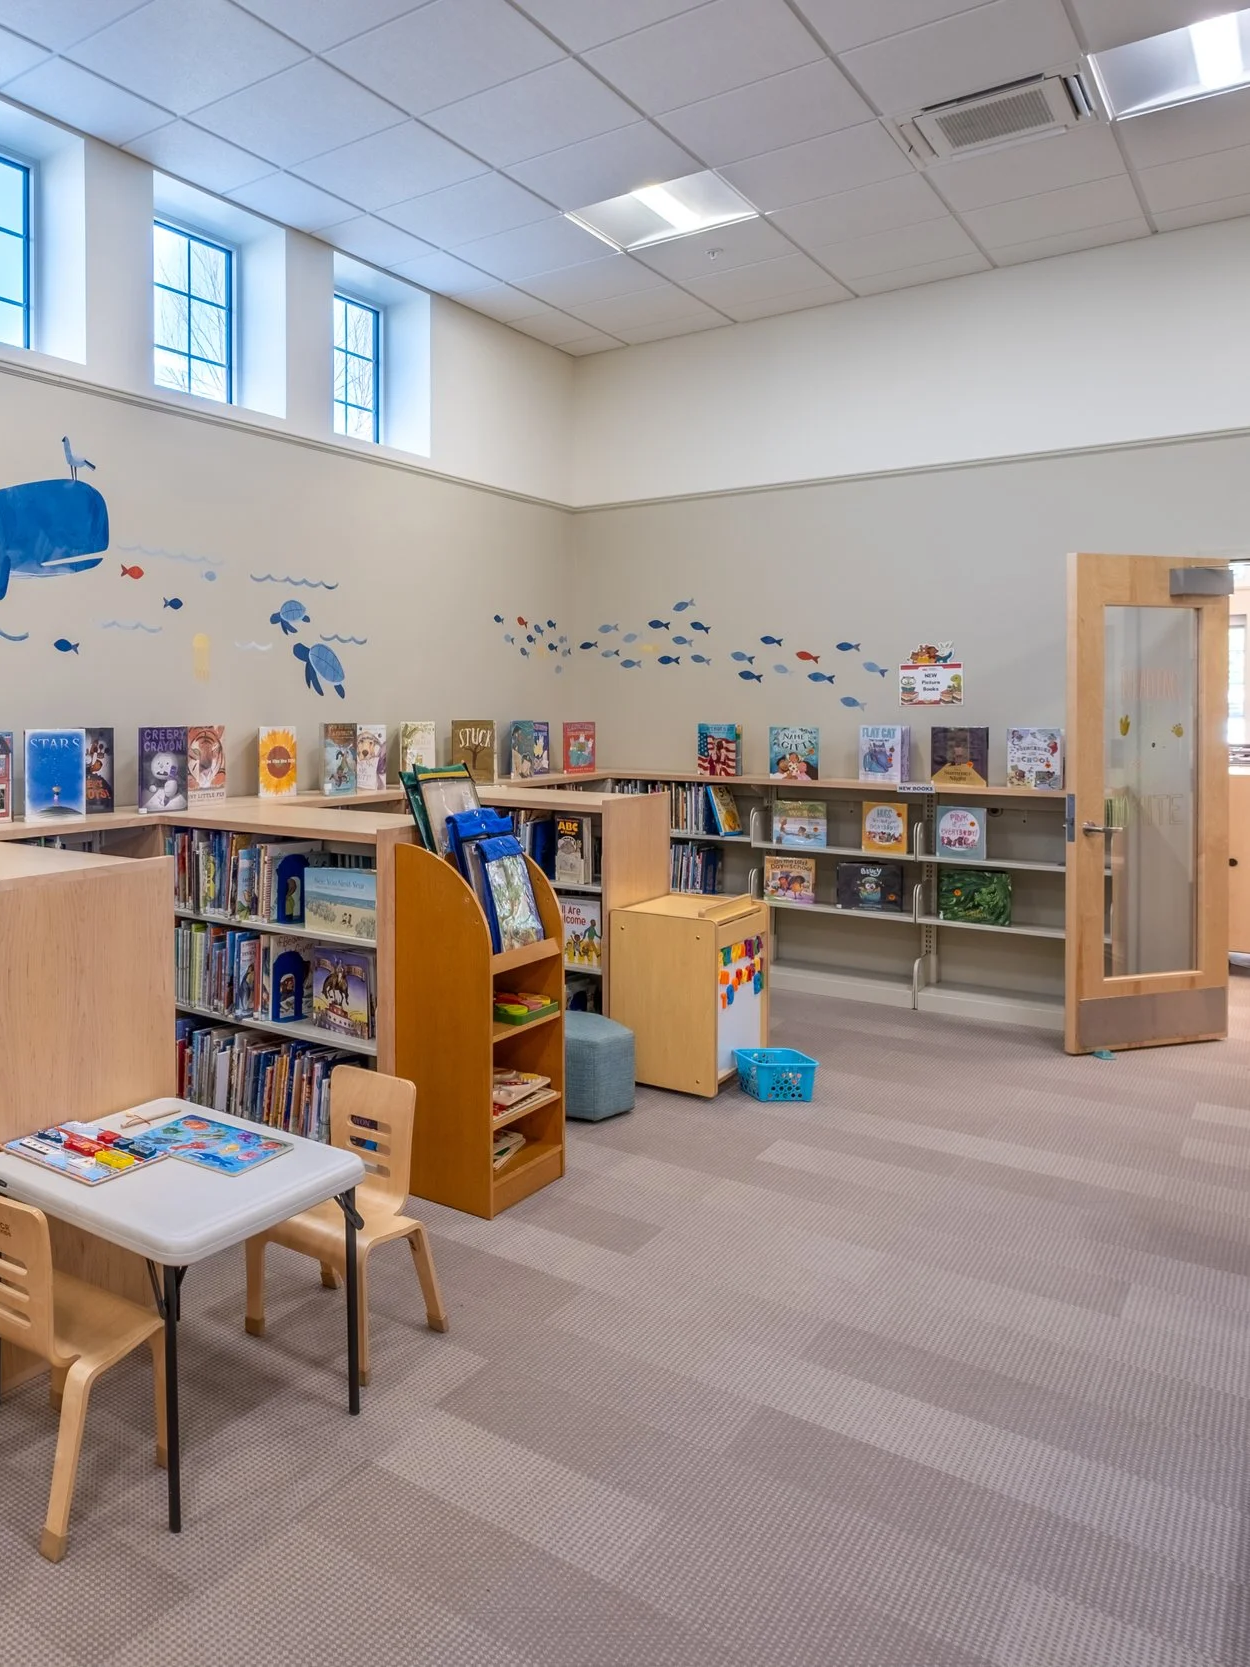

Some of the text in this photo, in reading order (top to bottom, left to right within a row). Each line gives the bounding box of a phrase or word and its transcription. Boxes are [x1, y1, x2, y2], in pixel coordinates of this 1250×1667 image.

[145, 729, 186, 740] CREEPY
[459, 728, 493, 748] STUCK
[862, 727, 897, 739] FLAT CAT
[30, 738, 81, 749] STARS
[144, 741, 186, 752] CRAYON!
[558, 821, 579, 832] ABC
[568, 906, 581, 915] Are
[564, 915, 587, 926] lcome
